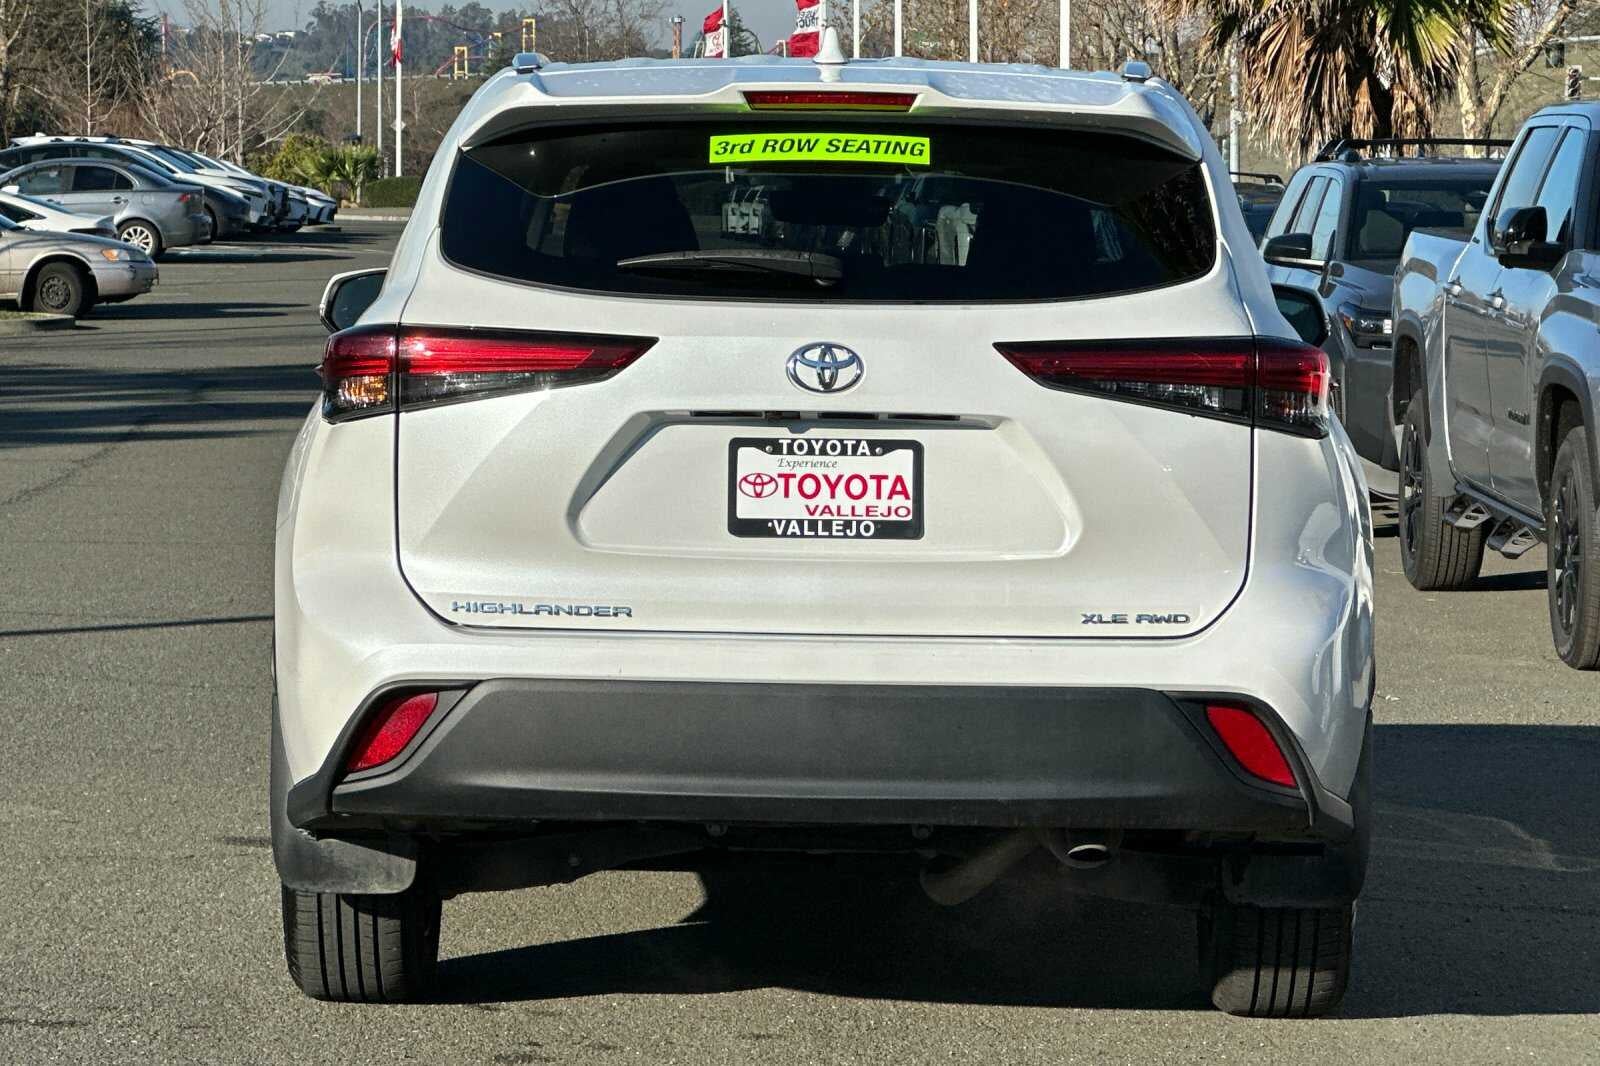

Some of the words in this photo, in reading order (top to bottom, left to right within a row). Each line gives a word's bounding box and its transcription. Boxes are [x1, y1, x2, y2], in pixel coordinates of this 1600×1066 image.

[714, 140, 755, 156] 3rd
[762, 138, 820, 153] ROW
[825, 138, 926, 157] SEATING
[778, 439, 871, 456] TOYOTA
[777, 457, 838, 471] Experience
[777, 473, 911, 501] TOYOTA
[804, 504, 912, 518] VALLEJO
[773, 519, 875, 537] VALLEJO
[452, 601, 633, 618] HIGHLANDER
[1081, 613, 1129, 625] XLE
[1135, 613, 1191, 625] AWD
